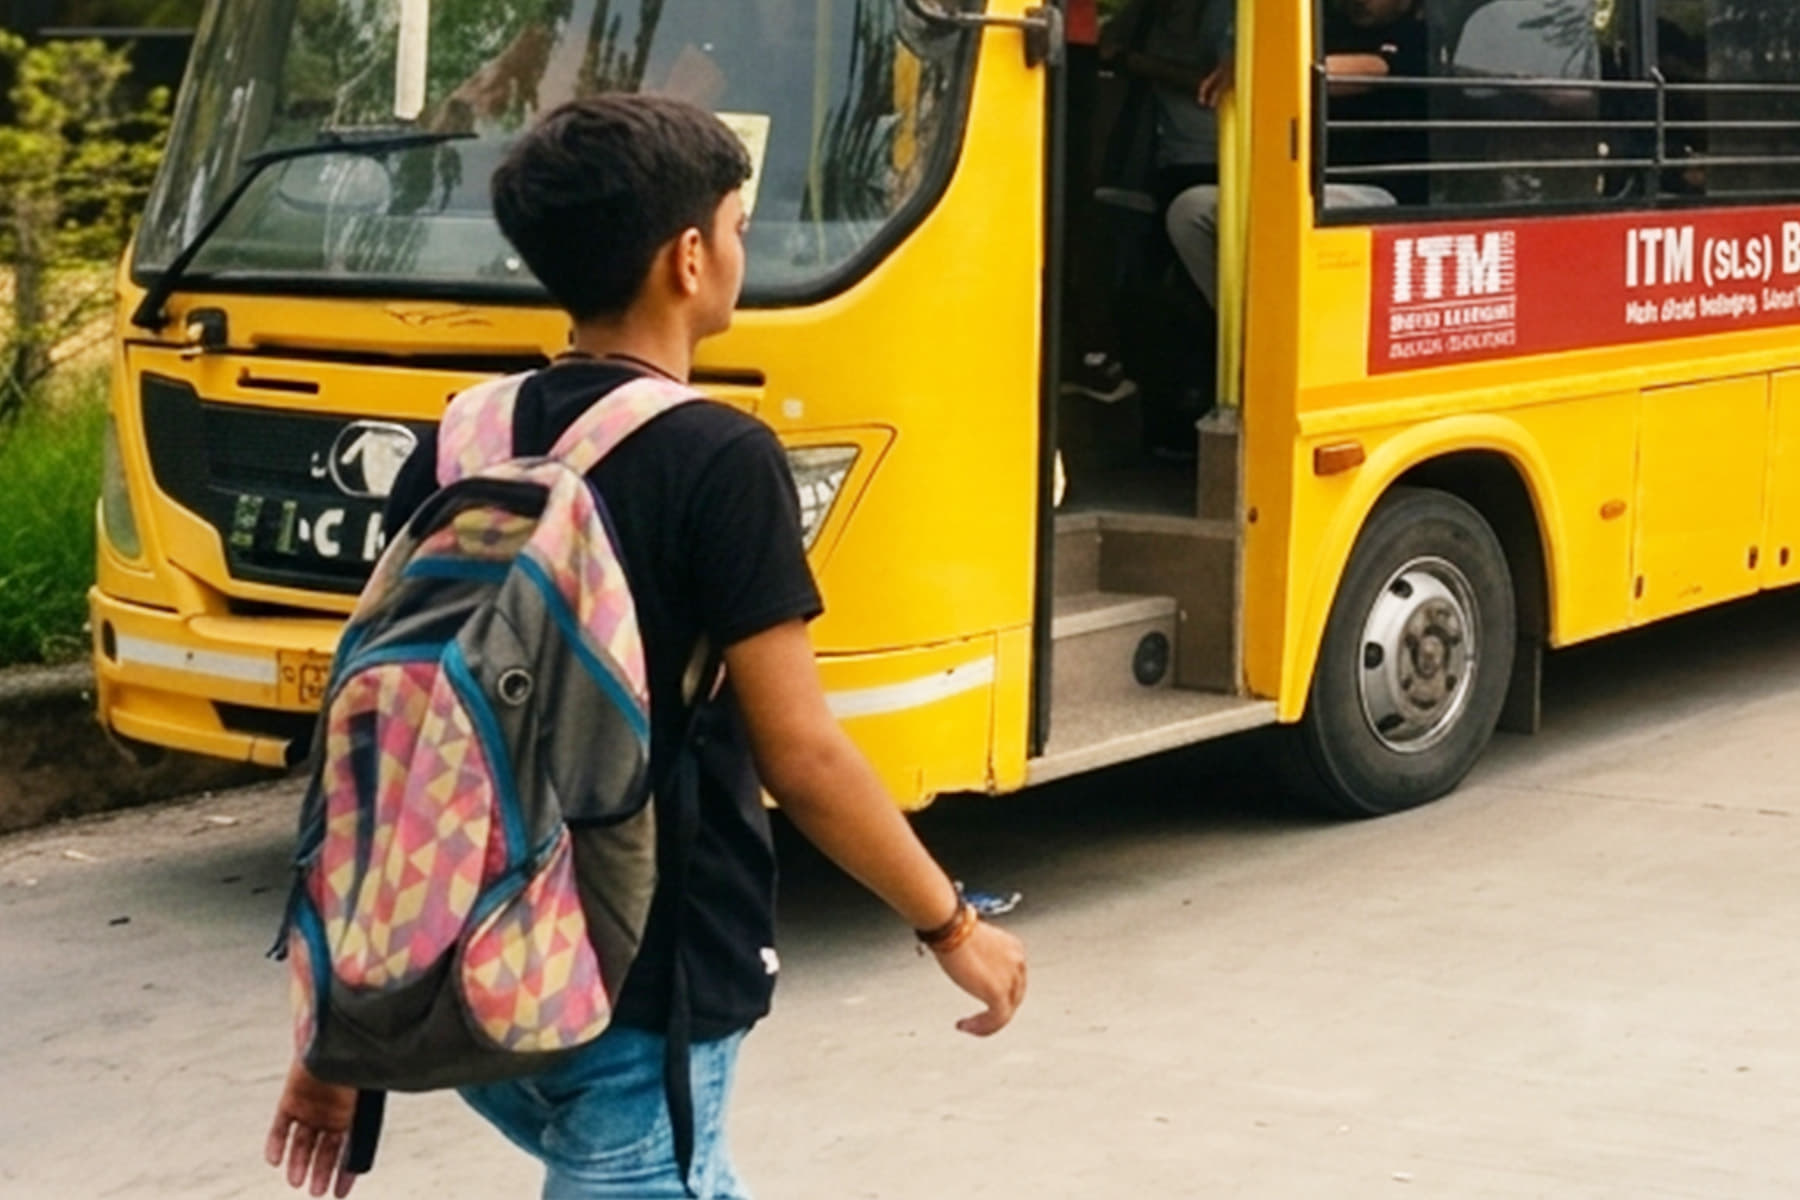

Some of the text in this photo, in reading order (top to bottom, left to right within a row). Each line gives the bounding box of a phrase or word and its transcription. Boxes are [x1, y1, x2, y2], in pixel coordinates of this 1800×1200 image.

[1393, 231, 1501, 303] ITM
[1625, 224, 1695, 288] ITM
[1702, 234, 1773, 288] (SLS)
